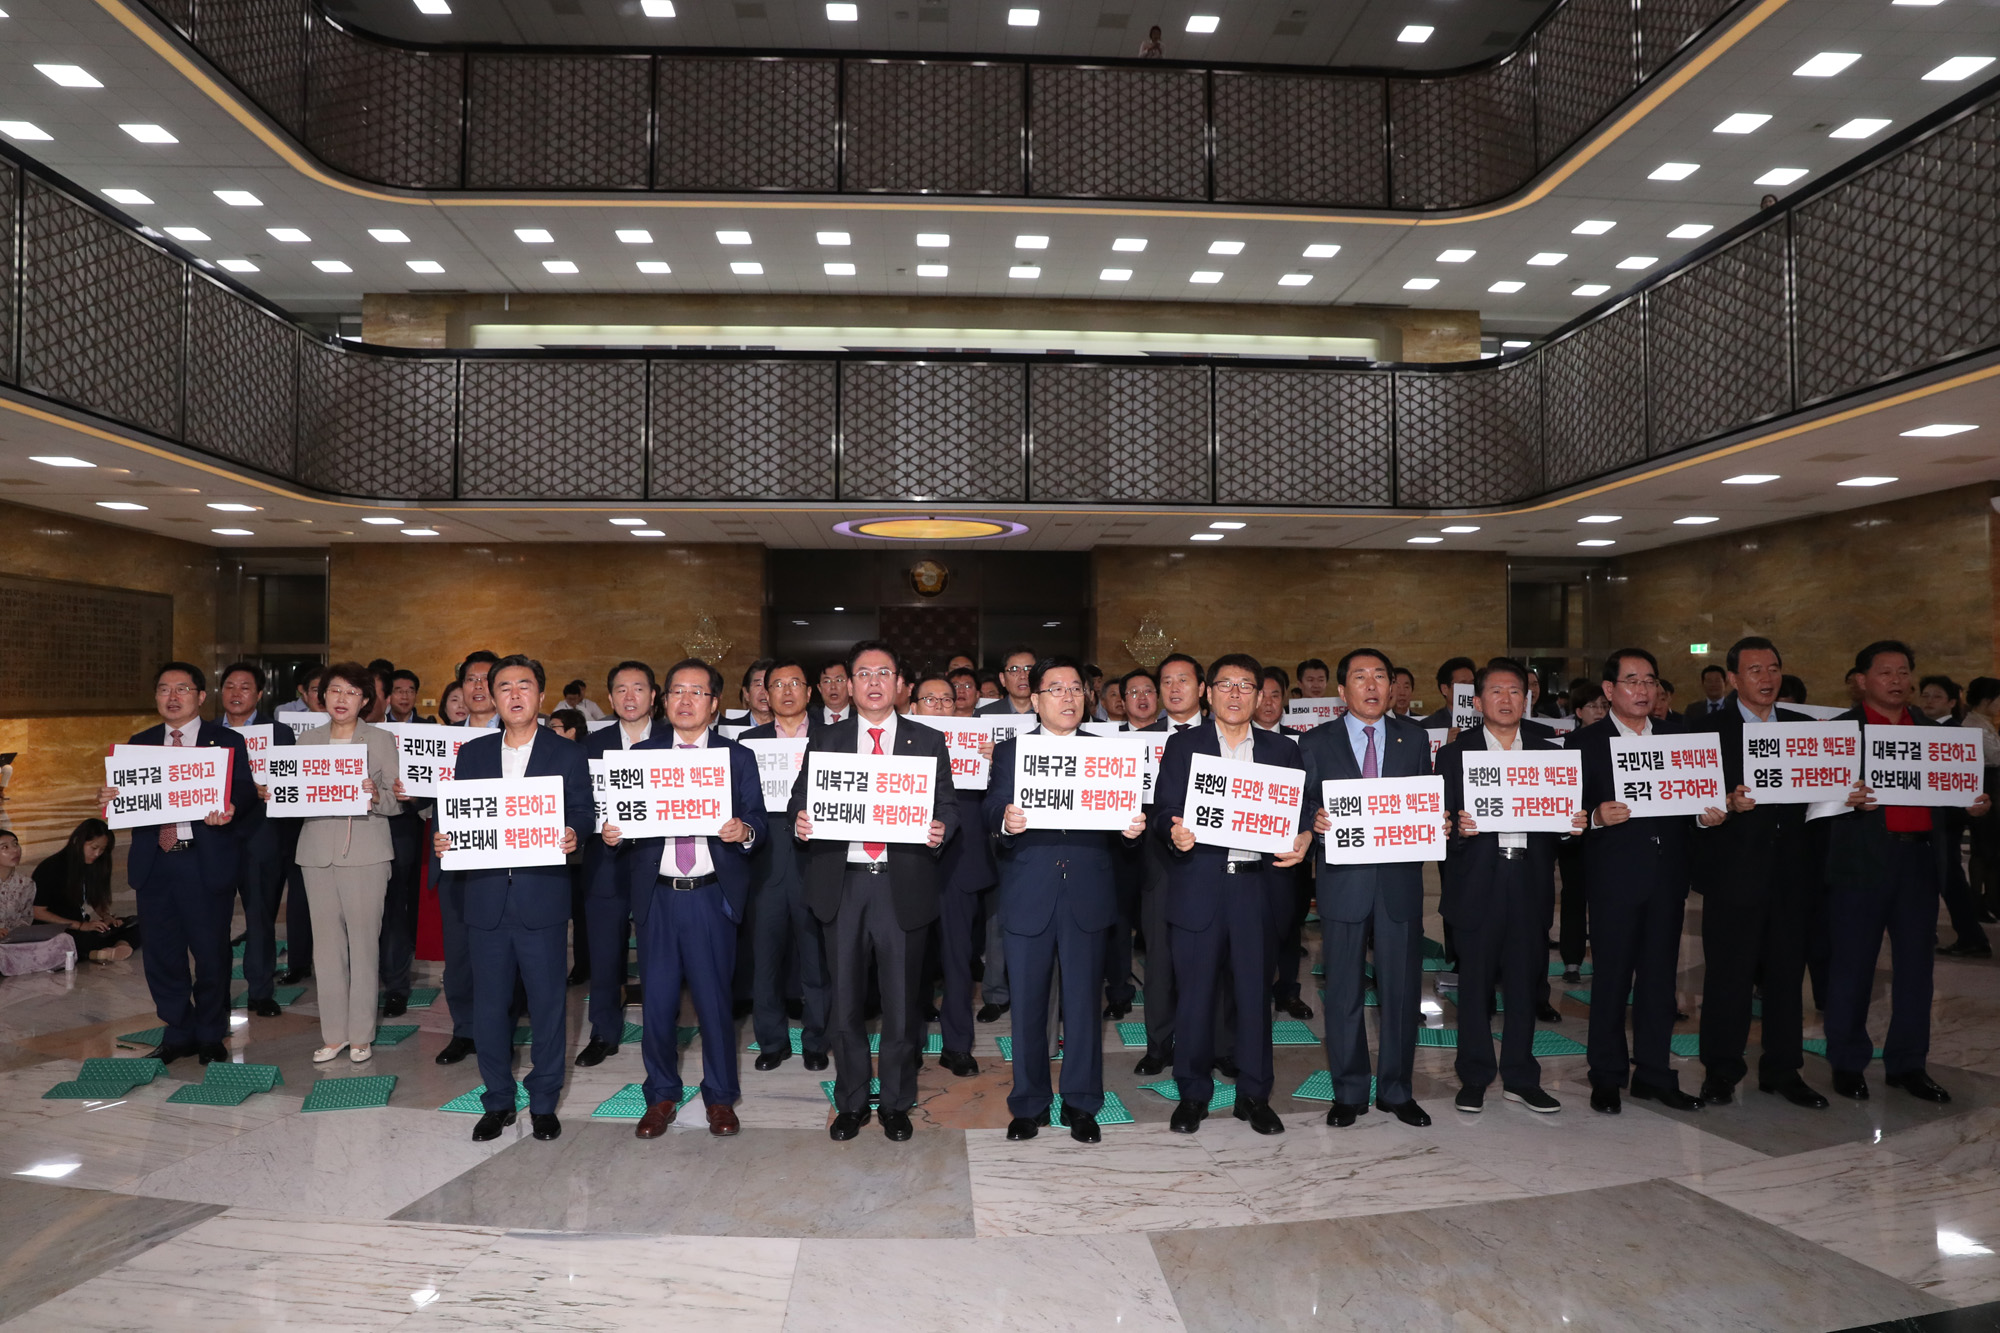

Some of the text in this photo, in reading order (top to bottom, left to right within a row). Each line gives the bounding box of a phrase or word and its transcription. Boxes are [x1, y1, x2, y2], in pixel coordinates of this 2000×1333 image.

[404, 738, 447, 757] 국민지킬
[1748, 737, 1856, 758] 북한의 무모한 핵도발
[1873, 741, 1977, 762] 대북구걸 중단하고
[270, 759, 363, 777] 북한의 무모한 핵도발
[950, 758, 981, 777] 한다!
[1024, 755, 1136, 778] 대북구걸 중단하고
[1617, 749, 1718, 771] 국민지킬 북핵대책
[111, 762, 215, 788] 대북구걸 중단하고
[407, 765, 433, 783] 즉각
[610, 769, 643, 789] 북한의
[650, 767, 685, 788] 무모한
[690, 767, 725, 787] 핵도발
[816, 770, 927, 794] 대북구걸 중단하고
[1469, 767, 1577, 786] 북한의 무모한 핵도발
[1754, 767, 1851, 788] 엄중 규탄한다!
[1869, 770, 1978, 792] 안보태세 확립하라!
[111, 788, 218, 814] 안보태세 확립하라!
[274, 785, 358, 803] 엄중 규탄한다!
[1019, 788, 1136, 812] 안보태세 확립하라!
[1195, 773, 1302, 809] 북한의 무모한 핵도발
[1622, 779, 1718, 804] 즉각 강구하라!
[446, 795, 556, 819] 대북구걸 중단하고
[617, 801, 647, 821] 엄중
[656, 799, 720, 820] 규탄한다!
[811, 802, 927, 826] 안보태세 확립하라!
[1327, 793, 1440, 818] 북한의 무모한 핵도발
[1475, 797, 1575, 819] 엄중 규탄한다!
[1196, 806, 1290, 837] 엄중 규탄한다!
[446, 827, 560, 852] 안보태세 확립하라!
[1336, 824, 1435, 847] 엄중 규탄한다!
